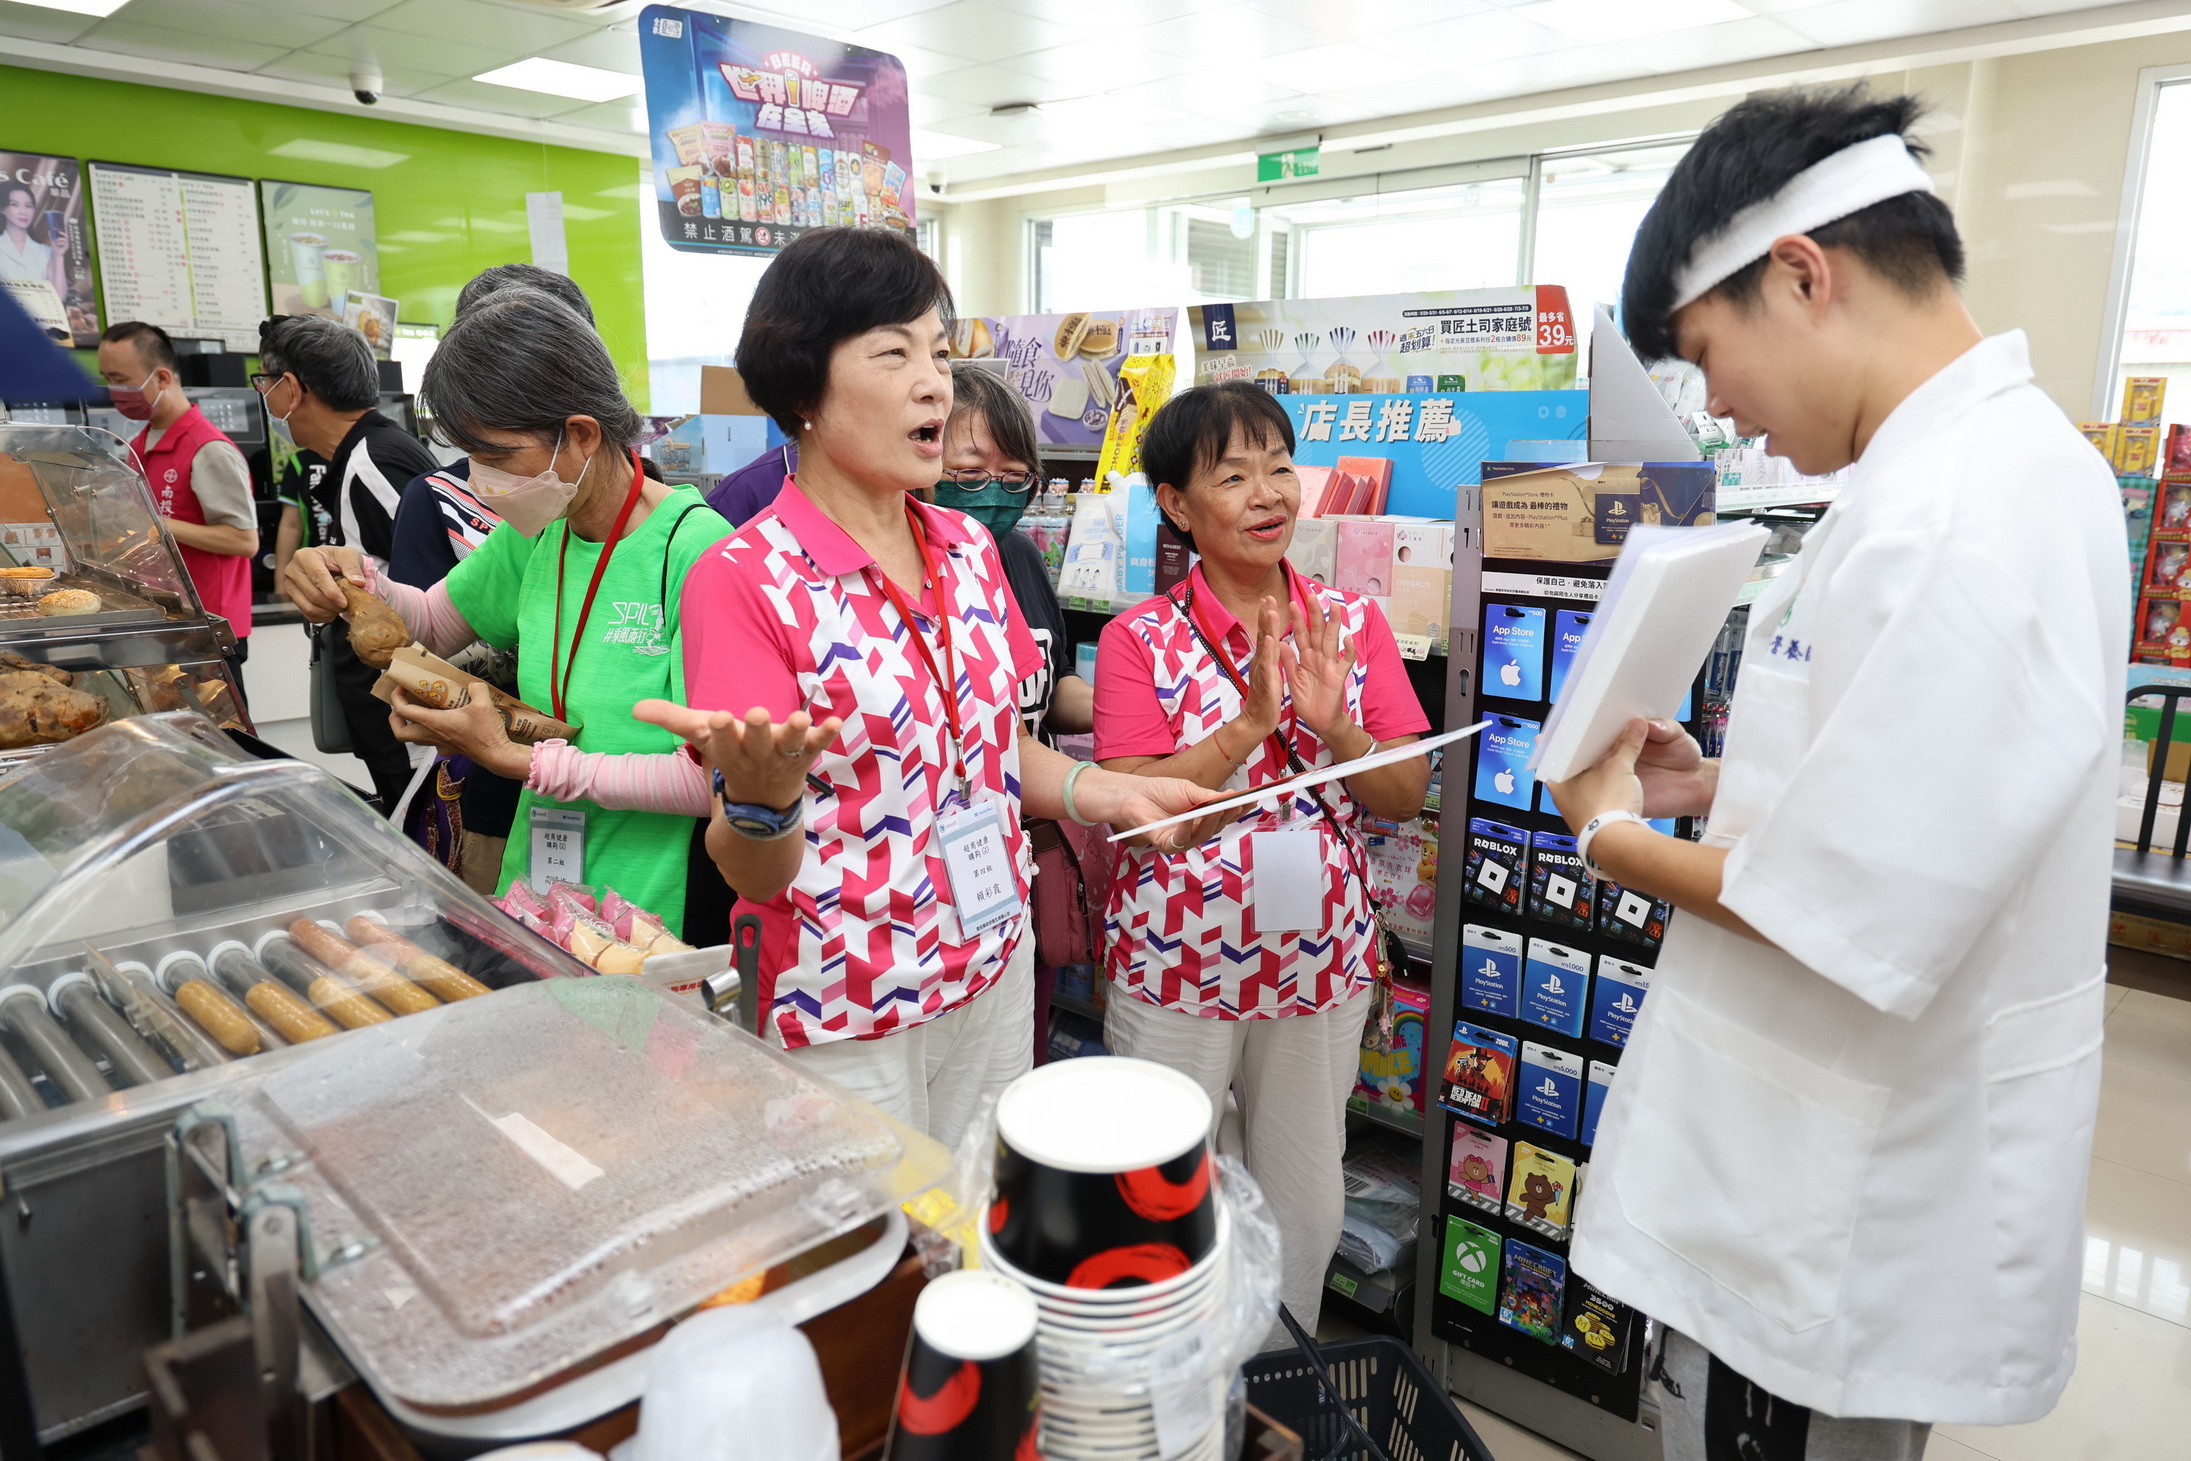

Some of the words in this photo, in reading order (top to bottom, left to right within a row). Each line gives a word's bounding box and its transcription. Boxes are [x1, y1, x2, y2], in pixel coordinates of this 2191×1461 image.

[769, 52, 812, 77] BEER
[755, 103, 835, 138] 在全家
[15, 168, 70, 188] Café
[684, 222, 752, 244] 禁止酒駕
[1440, 317, 1532, 335] 買匠土司家庭號
[1538, 312, 1565, 323] 最多省
[1211, 320, 1231, 342] 匠
[1399, 325, 1435, 343] 週末五六日
[1539, 324, 1574, 346] 39元
[1005, 337, 1043, 369] 隨食
[1299, 398, 1454, 443] 店長推薦
[160, 485, 175, 518] 南投
[1491, 501, 1528, 510] 讓遊戲成為
[1529, 502, 1568, 511] 最棒的禮物
[1493, 625, 1510, 636] App
[1511, 626, 1534, 637] Store
[1562, 632, 1581, 644] App
[1488, 733, 1506, 744] App
[1507, 736, 1530, 749] Store
[1474, 838, 1518, 857] ROBLOX
[547, 857, 565, 866] 第二組
[1538, 852, 1583, 867] ROBLOX
[973, 864, 993, 879] 第四組
[1475, 977, 1504, 989] PlayStation
[1536, 992, 1567, 1007] PlayStation
[1531, 1094, 1562, 1109] PlayStation
[1513, 1253, 1557, 1278] MINECRAFT
[1452, 1269, 1467, 1281] GIFT
[1467, 1274, 1485, 1288] CARD
